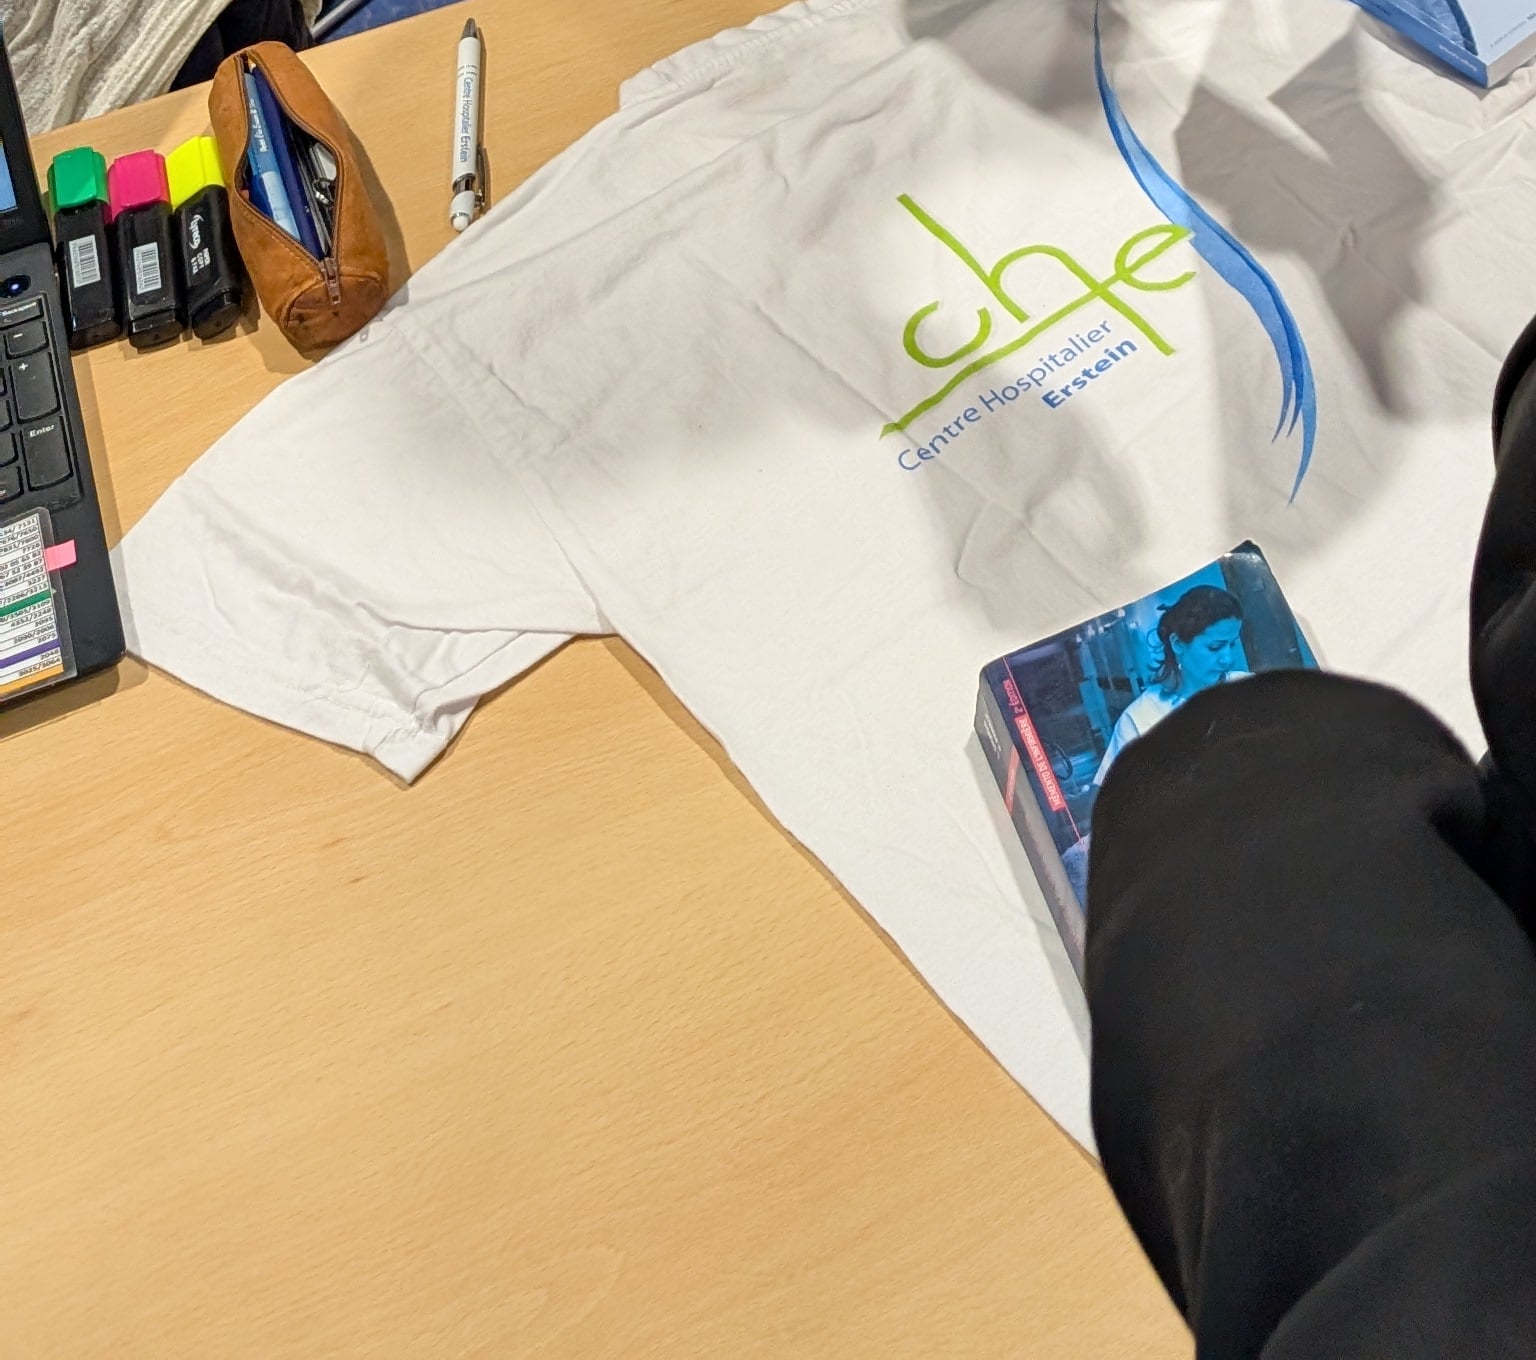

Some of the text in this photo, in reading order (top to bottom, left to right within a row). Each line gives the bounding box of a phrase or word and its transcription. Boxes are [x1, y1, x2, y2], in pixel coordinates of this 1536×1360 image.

[460, 77, 473, 163] Centre Hospitalier Erstein
[895, 192, 1198, 392] che
[897, 318, 1113, 473] Centre Hospitalier
[1041, 338, 1138, 410] Erstein
[29, 424, 55, 437] Enter
